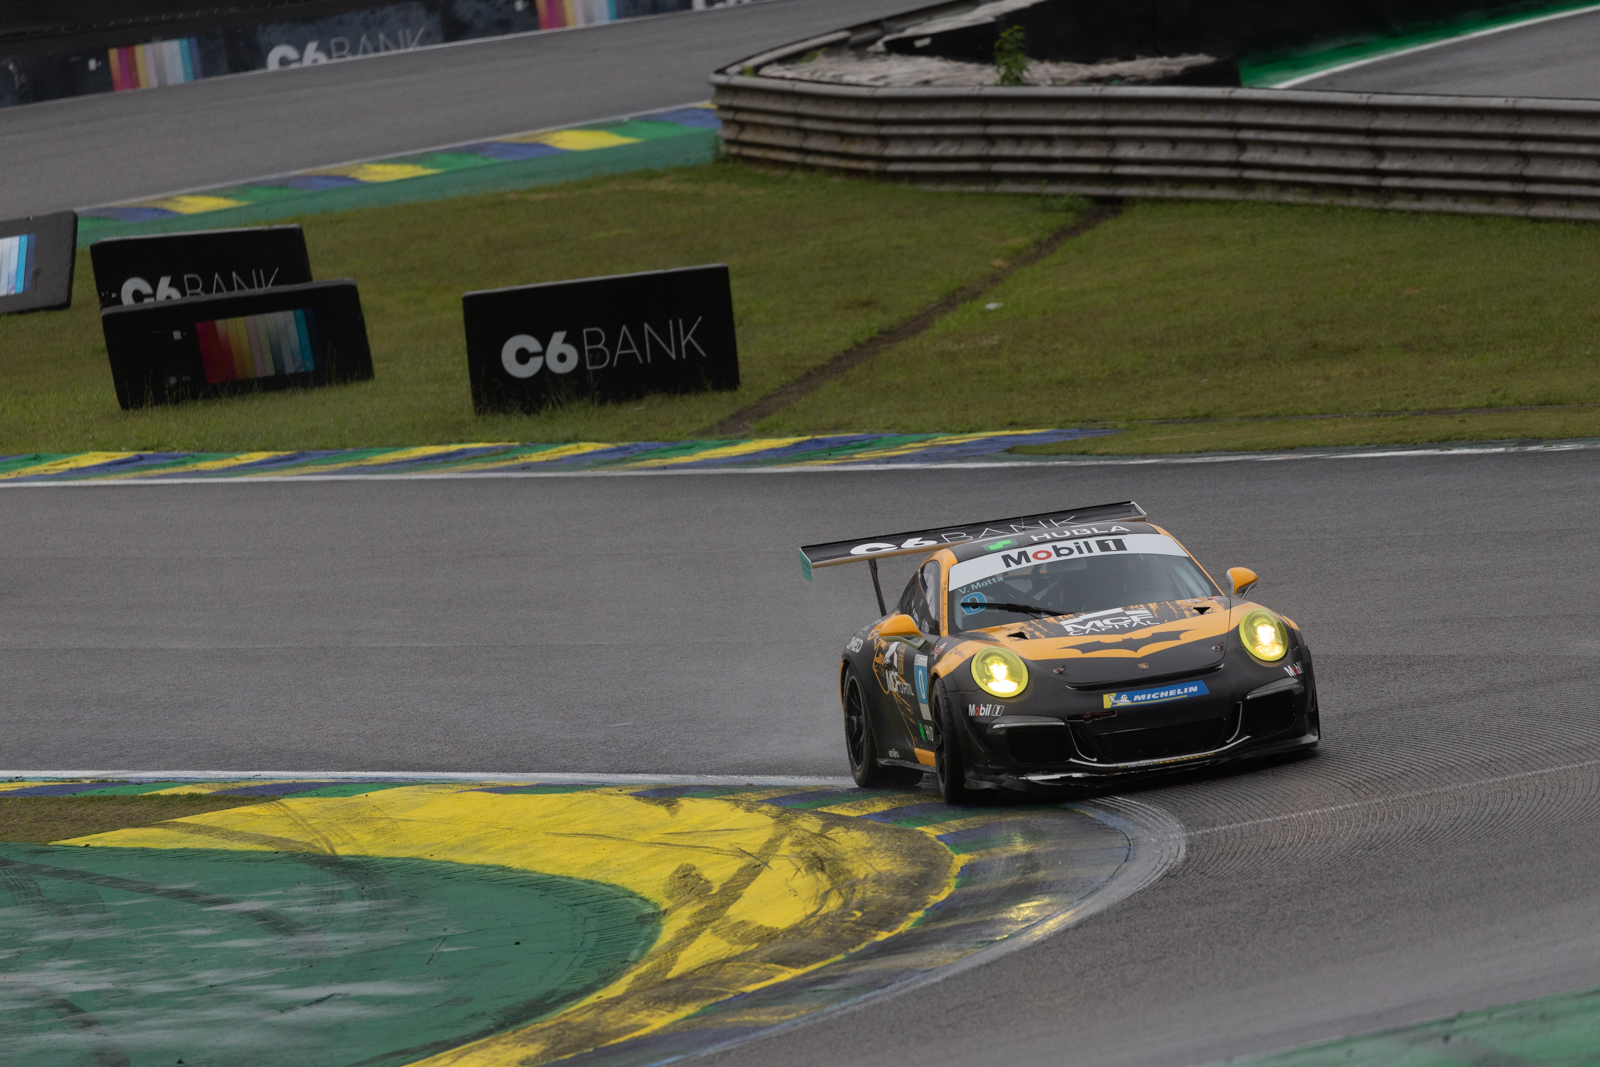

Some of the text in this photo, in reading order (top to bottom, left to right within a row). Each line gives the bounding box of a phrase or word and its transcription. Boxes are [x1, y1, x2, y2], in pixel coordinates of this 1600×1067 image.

[266, 25, 426, 70] C6 BANK
[120, 267, 280, 306] C6 BANK
[501, 316, 707, 378] C6 BANK
[1030, 525, 1131, 541] HUBLA
[850, 537, 937, 555] C6
[1001, 541, 1094, 568] Mobil
[971, 576, 1004, 591] Motta
[1070, 620, 1160, 636] CAPITAL
[1133, 685, 1198, 701] MICHELIN
[968, 703, 992, 717] Mobil
